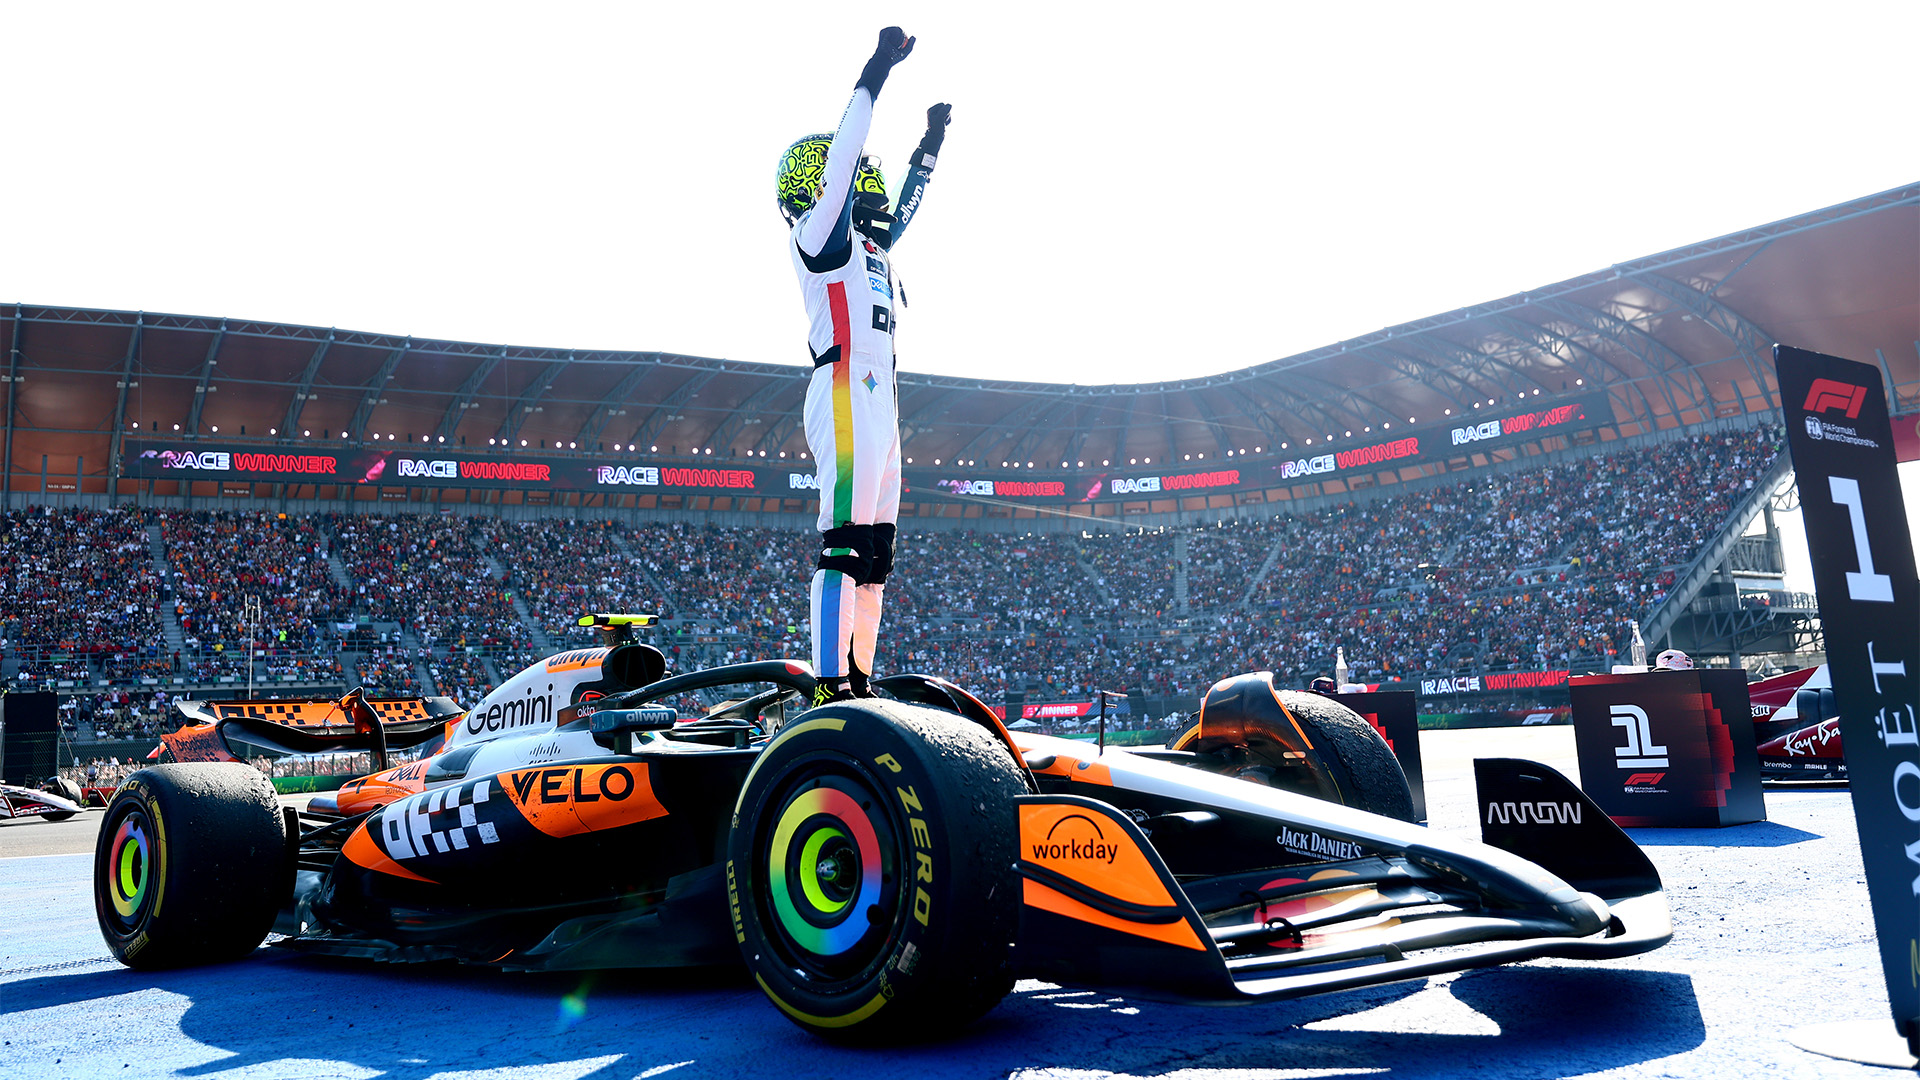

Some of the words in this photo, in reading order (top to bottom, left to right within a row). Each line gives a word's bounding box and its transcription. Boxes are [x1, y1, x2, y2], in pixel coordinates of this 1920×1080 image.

[900, 185, 922, 224] allwyn
[1452, 420, 1500, 445] RACE
[163, 450, 230, 471] RACE
[233, 452, 337, 474] WINNER
[398, 459, 458, 478] RACE
[460, 461, 550, 481] WINNER
[1281, 454, 1336, 479] RACE
[1336, 437, 1419, 469] WINNER
[598, 466, 659, 485] RACE
[661, 467, 755, 488] WINNER
[994, 481, 1066, 496] WINNER
[1111, 477, 1161, 494] RACE
[1161, 470, 1240, 491] WINNER
[1828, 476, 1895, 603] 1
[548, 650, 608, 667] allwyn
[1421, 676, 1481, 695] RACE
[467, 683, 554, 735] Gemini
[626, 709, 669, 724] allwyn
[1609, 705, 1669, 769] 1
[388, 763, 423, 782] DELL
[1764, 761, 1792, 769] brembo
[512, 765, 635, 806] VELO
[1488, 802, 1581, 824] ARROW
[874, 753, 902, 773] P
[897, 785, 933, 926] ZERO
[1032, 838, 1118, 864] workday
[1276, 826, 1309, 850] JACK
[1311, 832, 1362, 860] DANIEL'S
[727, 859, 745, 943] PIRELLI
